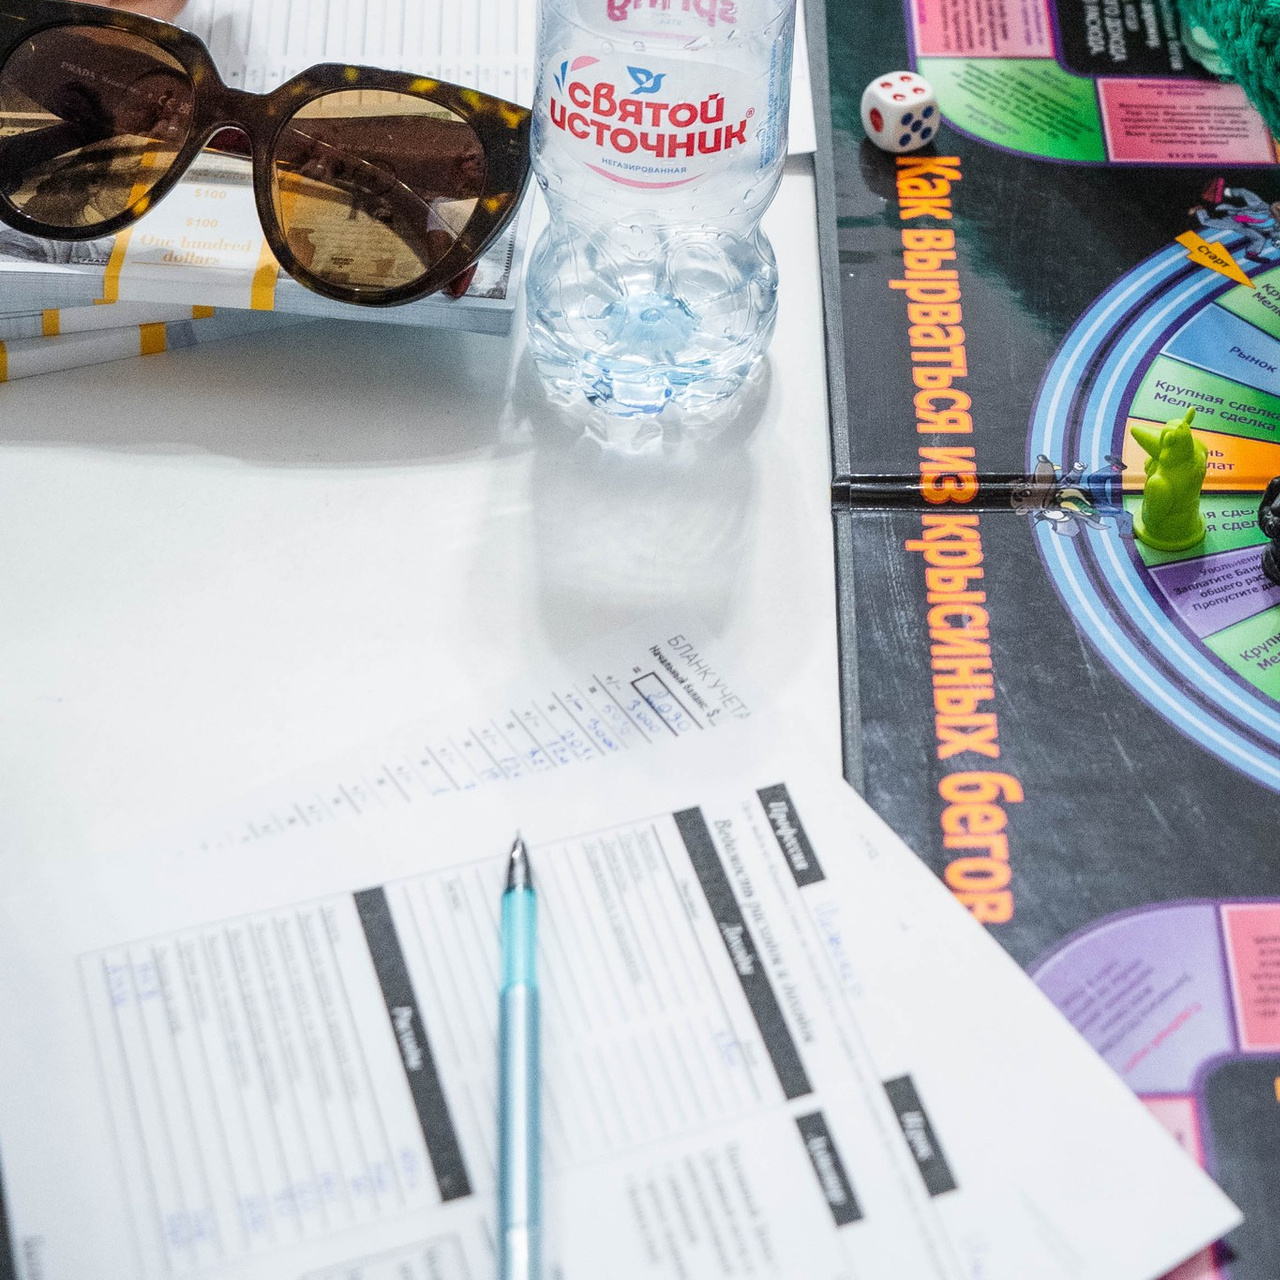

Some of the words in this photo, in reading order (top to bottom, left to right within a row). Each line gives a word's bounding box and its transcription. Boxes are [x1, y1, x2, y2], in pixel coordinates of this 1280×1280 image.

[601, 157, 687, 174] НЕГАЗИРОВАННАЯ
[894, 155, 962, 221] Как
[185, 216, 218, 229] $100
[139, 232, 174, 251] One
[179, 235, 252, 254] hundred
[161, 250, 221, 265] dollars
[1196, 243, 1230, 270] Старт
[888, 228, 973, 435] вырваться
[1228, 344, 1278, 373] Рынок
[1154, 379, 1224, 405] Крупная
[1218, 409, 1277, 432] сделка
[916, 445, 981, 505] из
[1199, 552, 1264, 577] Увольнени
[1173, 571, 1233, 596] Заплатите
[1199, 579, 1242, 598] общего
[1192, 585, 1259, 612] Пропустите
[904, 512, 1000, 757] крысиных
[665, 633, 716, 681] БЛАНК
[938, 771, 1024, 924] бегов
